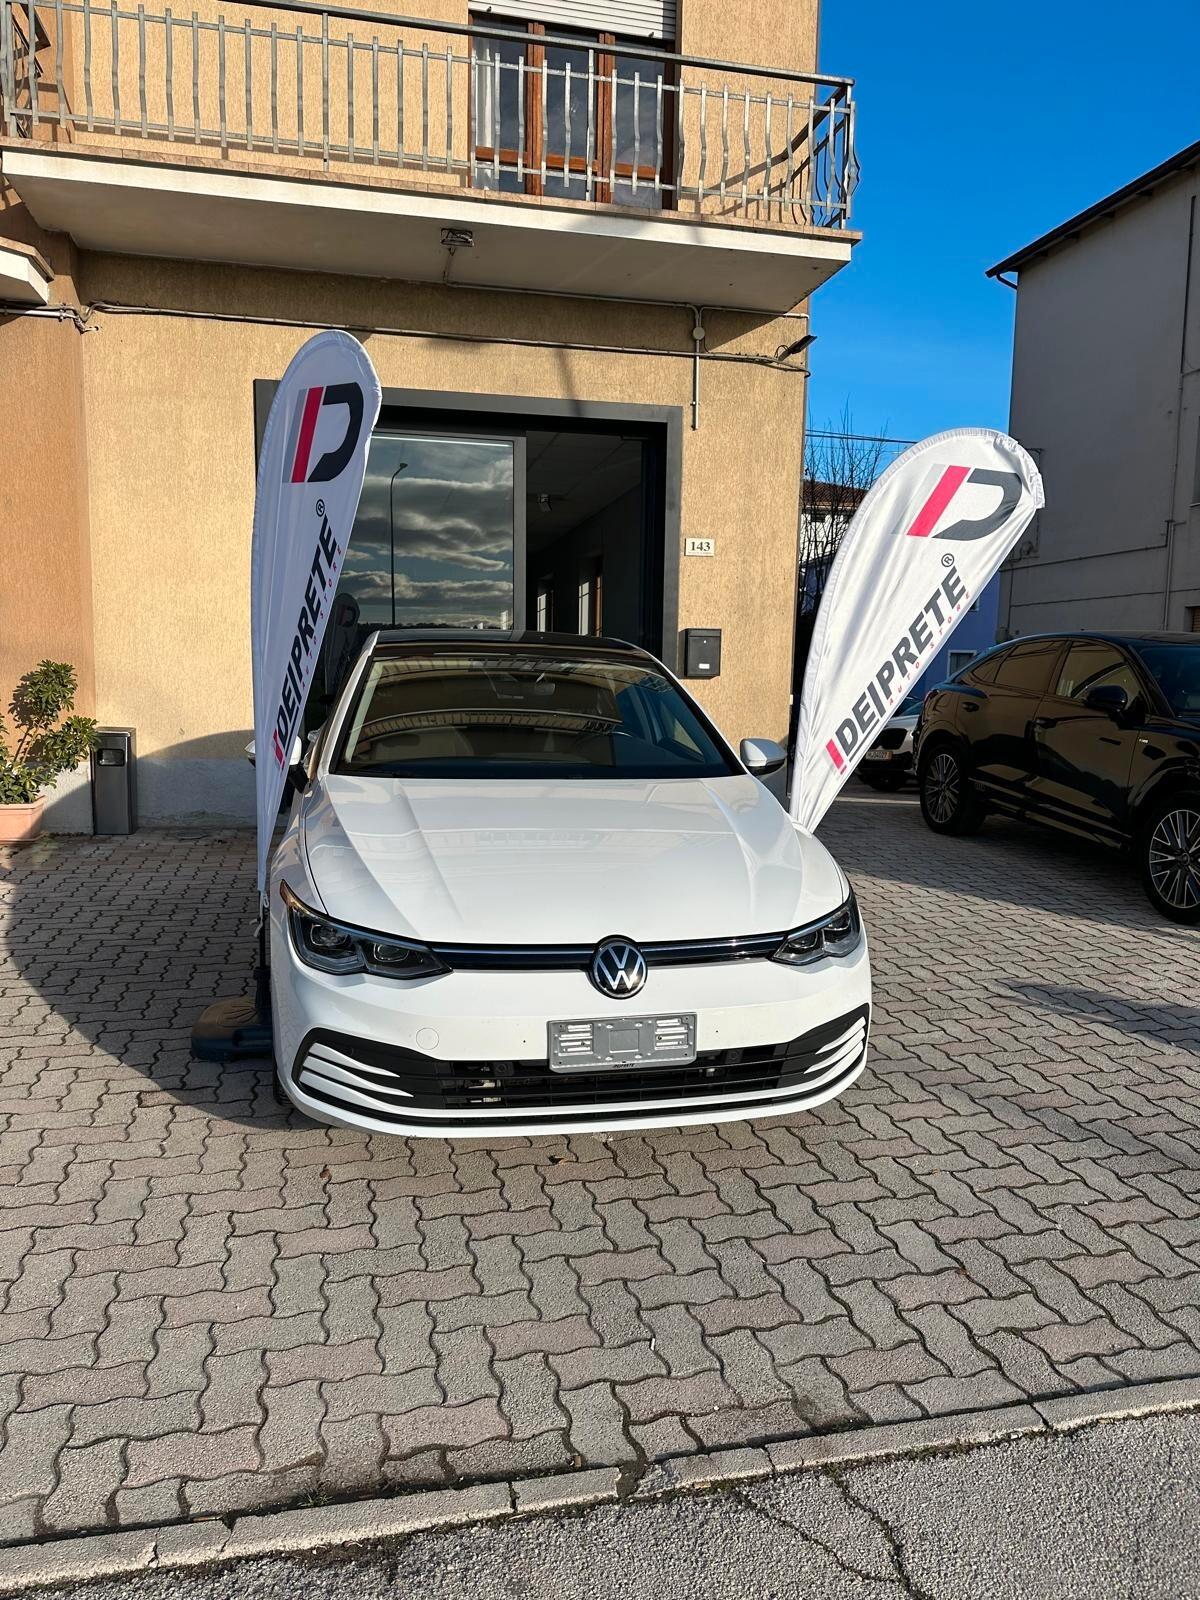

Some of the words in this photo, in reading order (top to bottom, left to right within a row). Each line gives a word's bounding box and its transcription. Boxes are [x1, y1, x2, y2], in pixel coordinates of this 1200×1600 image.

[691, 541, 710, 552] 143
[301, 635, 318, 689] AUTO
[320, 546, 342, 620] STORE
[889, 661, 921, 706] AUTO
[930, 591, 972, 649] STORE
